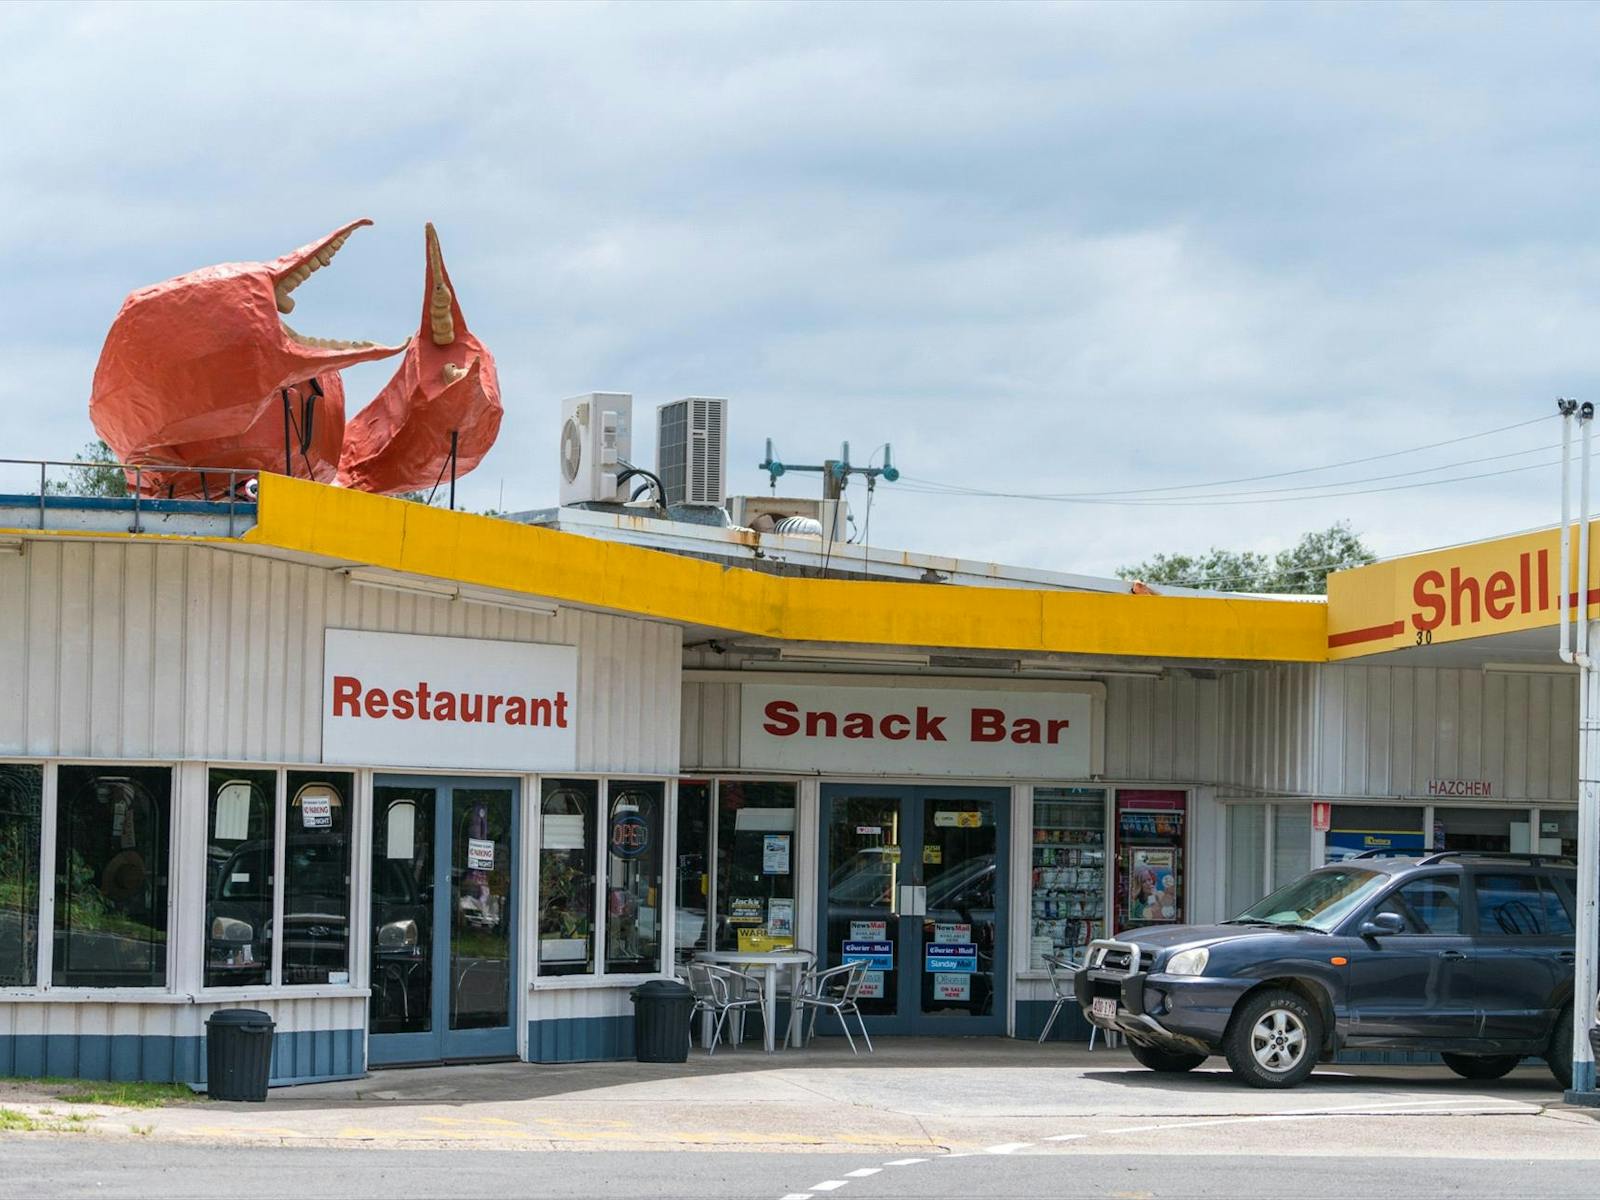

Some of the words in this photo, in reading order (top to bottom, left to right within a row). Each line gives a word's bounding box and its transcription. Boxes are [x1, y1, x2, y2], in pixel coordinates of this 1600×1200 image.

[1411, 549, 1549, 631] Shell
[333, 676, 568, 728] Restaurant
[763, 700, 947, 741] Snack
[970, 708, 1069, 744] Bar
[1428, 781, 1491, 795] HAZCHEM
